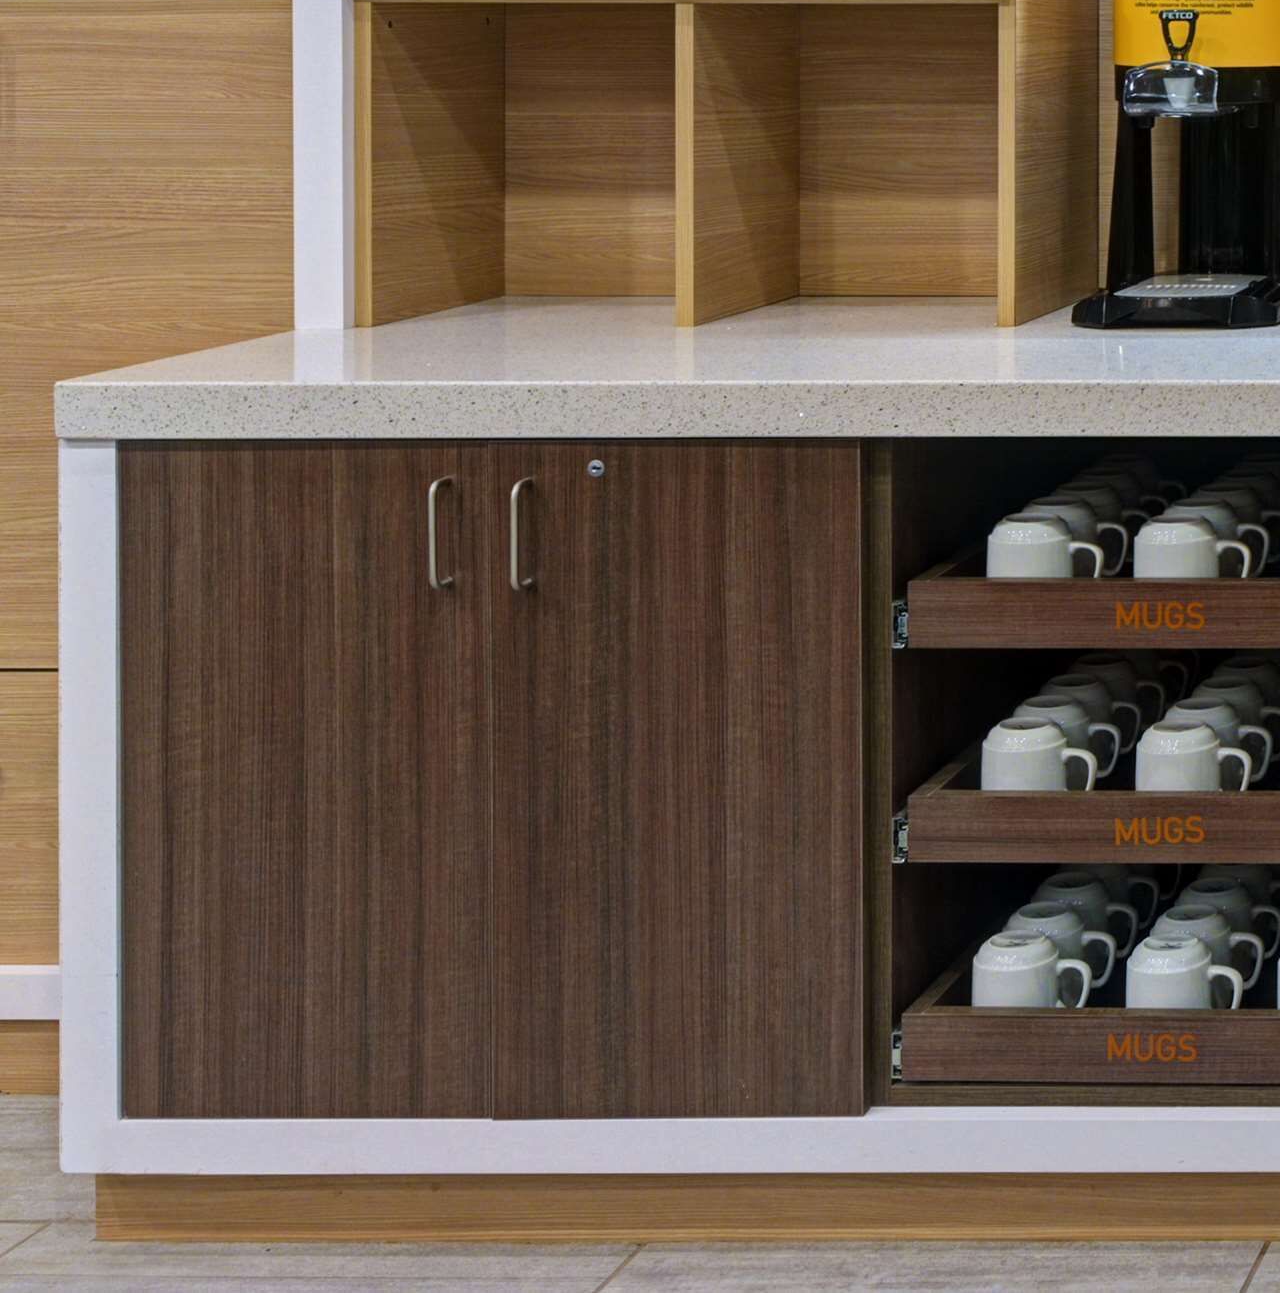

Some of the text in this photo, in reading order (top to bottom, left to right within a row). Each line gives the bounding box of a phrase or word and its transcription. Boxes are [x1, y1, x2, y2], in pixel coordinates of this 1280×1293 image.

[1162, 11, 1194, 20] FETCO
[1114, 601, 1206, 631] MUGS
[1114, 815, 1206, 845] MUGS
[1106, 1032, 1198, 1063] MUGS
